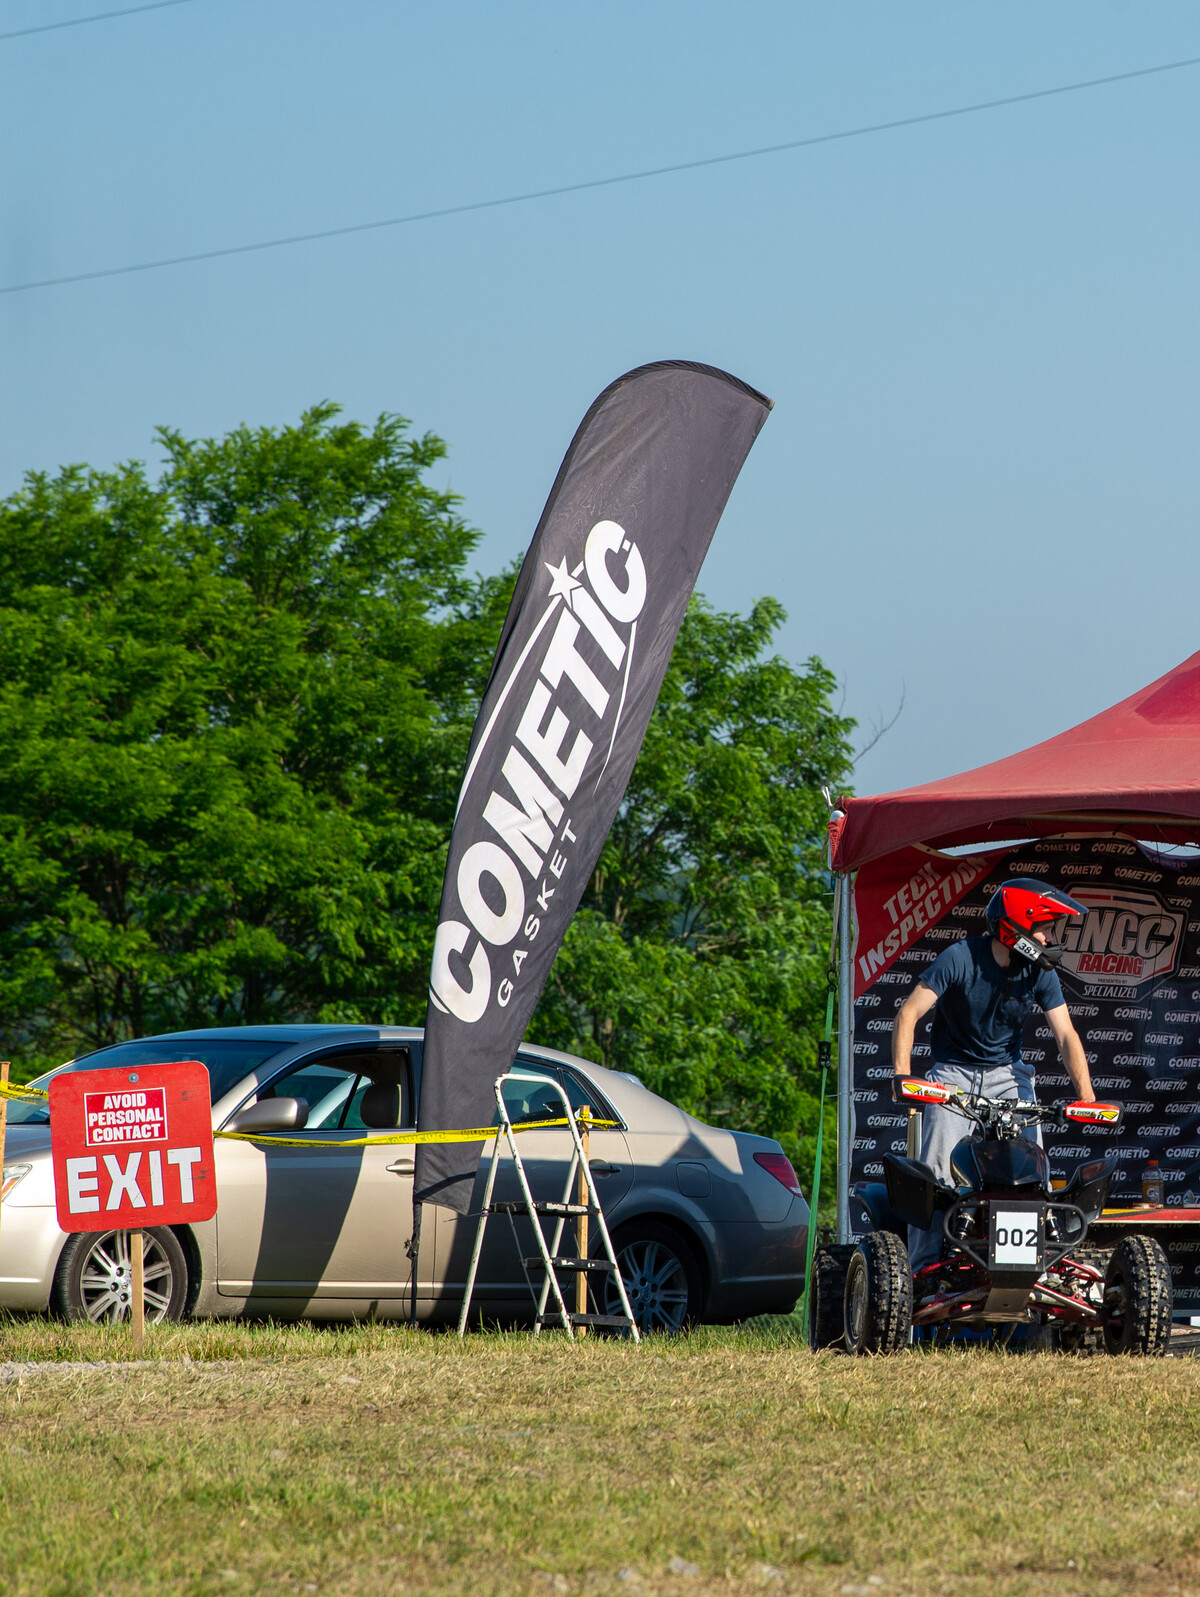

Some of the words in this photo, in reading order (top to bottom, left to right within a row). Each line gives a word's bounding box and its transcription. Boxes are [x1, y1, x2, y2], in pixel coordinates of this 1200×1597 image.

[430, 520, 647, 1023] COMETIC
[1035, 843, 1080, 852] COMETIC
[1091, 841, 1137, 856] COMETIC
[1010, 862, 1049, 874] COMETIC
[1060, 864, 1102, 875] COMETIC
[1115, 867, 1162, 882] COMETIC
[497, 818, 578, 1008] GASKET
[859, 857, 988, 982] INSPECTION
[925, 928, 967, 940] COMETIC
[1053, 909, 1176, 958] GNCC
[1018, 942, 1037, 957] 382
[1079, 953, 1143, 976] RACING
[1082, 984, 1137, 998] SPECIALIZED
[854, 996, 881, 1006] ETIC
[867, 1021, 893, 1030] COME
[1087, 1030, 1133, 1041] COMETIC
[1144, 1034, 1183, 1045] COMETIC
[853, 1044, 879, 1054] ETIC
[867, 1068, 894, 1078] COME
[1146, 1080, 1188, 1090] COMETIC
[104, 1092, 147, 1110] AVOID
[853, 1092, 878, 1101] ETIC
[1124, 1103, 1154, 1113] METIC
[88, 1108, 164, 1127] PERSONAL
[92, 1124, 162, 1142] CONTACT
[1041, 1124, 1069, 1134] METIC
[1137, 1126, 1180, 1136] COMETIC
[852, 1139, 876, 1149] ETIC
[1048, 1147, 1091, 1158] COMETIC
[1104, 1148, 1150, 1159] COMETIC
[66, 1146, 202, 1215] EXIT
[996, 1229, 1038, 1247] 002
